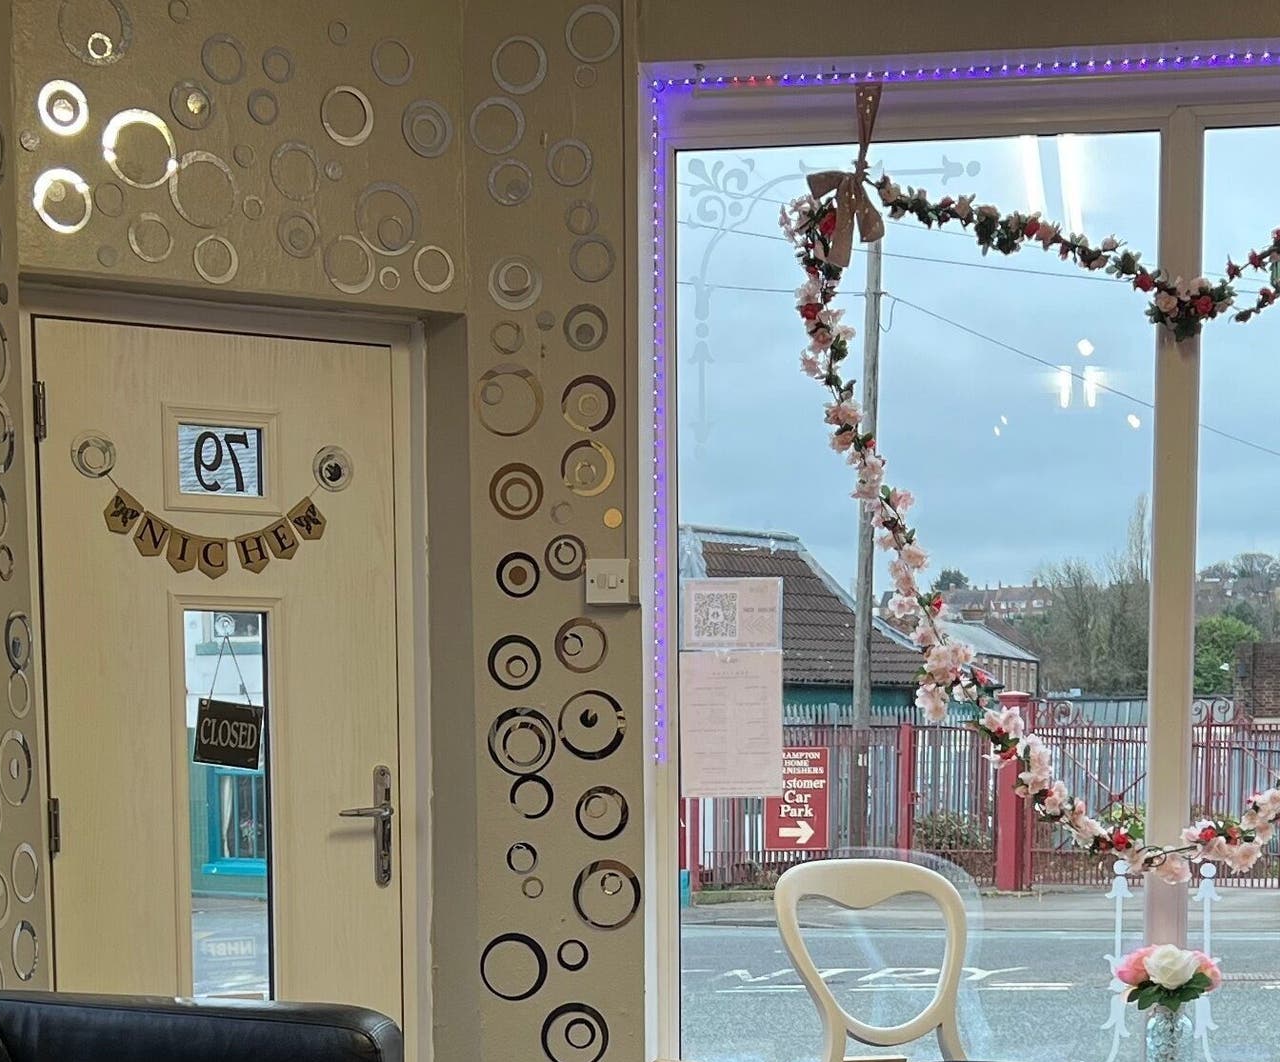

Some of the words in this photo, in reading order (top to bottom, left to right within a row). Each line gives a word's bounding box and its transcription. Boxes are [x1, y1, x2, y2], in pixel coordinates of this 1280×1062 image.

[138, 515, 295, 569] NICHE
[200, 716, 258, 751] CLOSED
[784, 759, 810, 767] HOME
[784, 789, 813, 804] Car
[779, 804, 815, 818] Park
